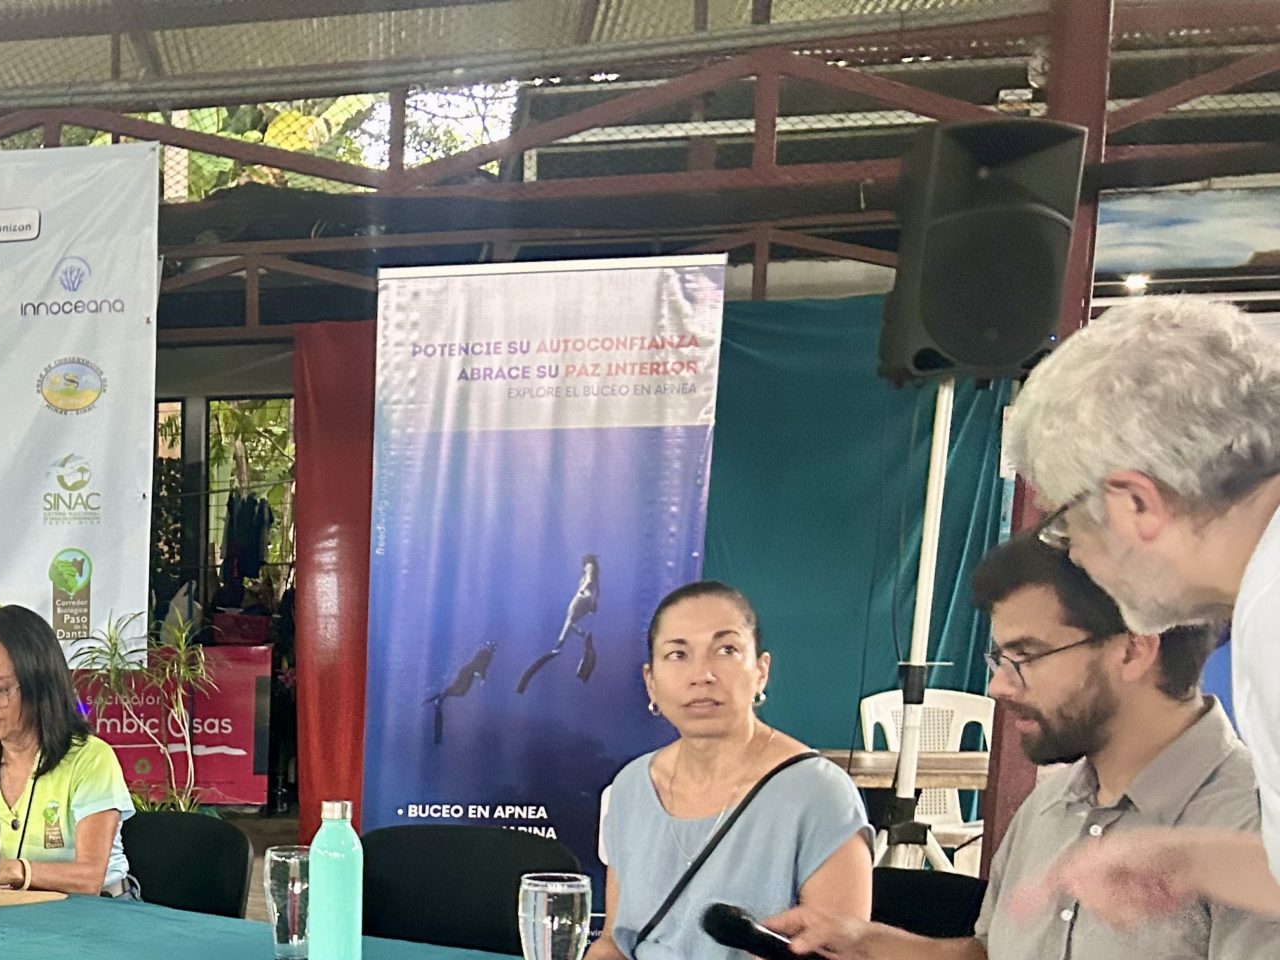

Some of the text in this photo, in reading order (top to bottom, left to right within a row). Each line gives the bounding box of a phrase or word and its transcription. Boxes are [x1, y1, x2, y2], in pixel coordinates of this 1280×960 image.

[412, 334, 700, 358] POTENCIE SU AUTOCONFIANZA
[457, 360, 698, 381] ABRACE SU PAZ INTERIOR
[507, 382, 697, 399] EXPLORE EL BUCEO EN APNEA
[43, 492, 101, 511] SINAC
[63, 614, 88, 624] Paso
[56, 629, 87, 639] Danta
[407, 804, 548, 819] BUCEO EN APNEA
